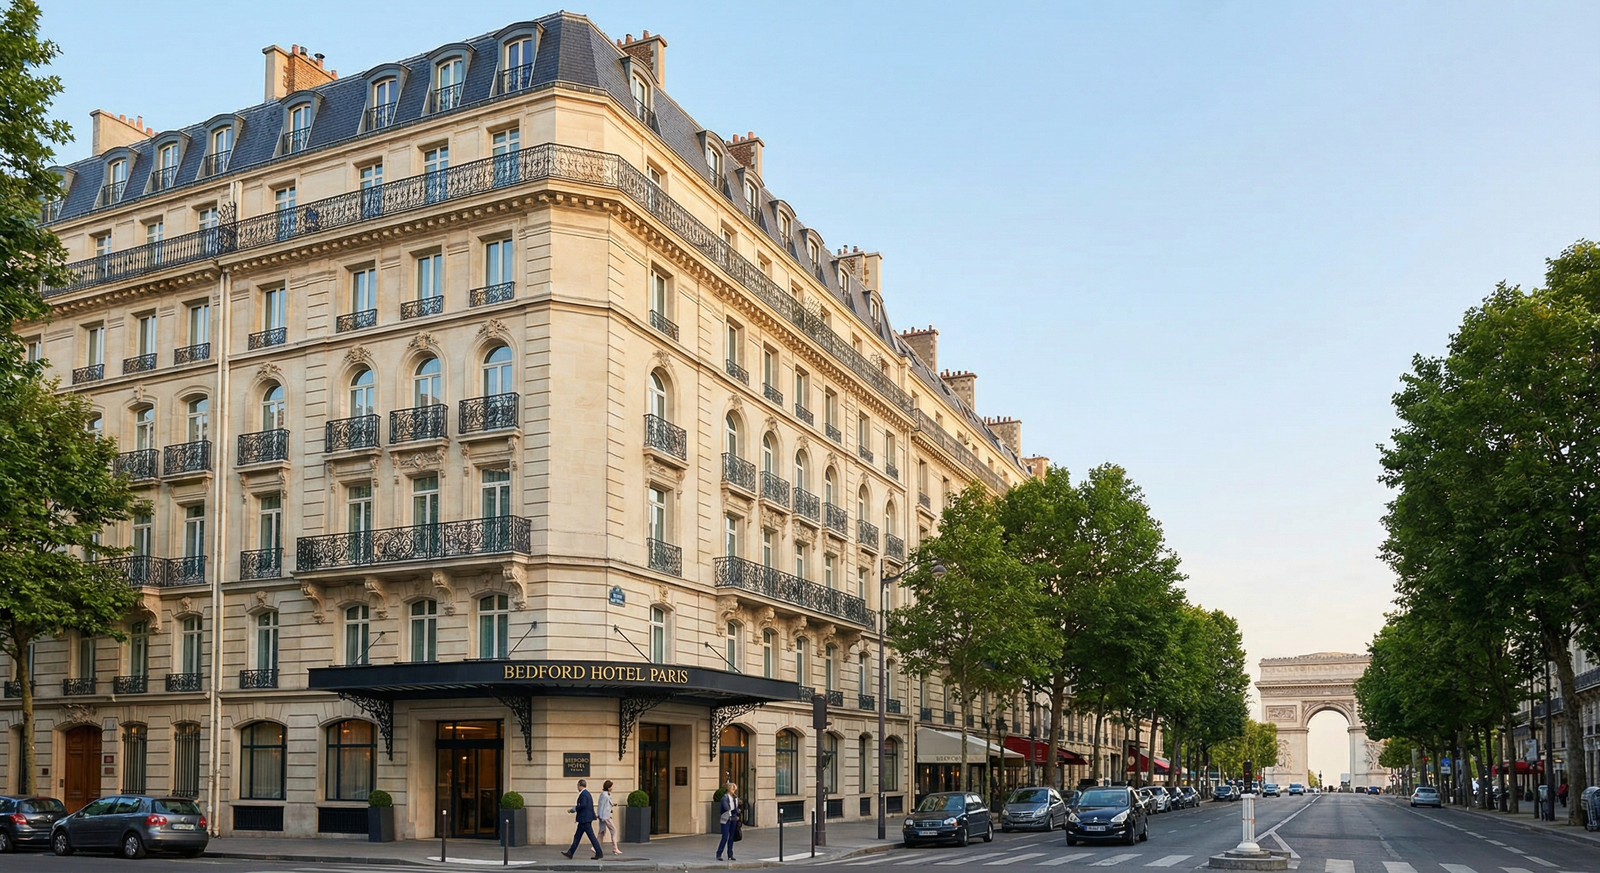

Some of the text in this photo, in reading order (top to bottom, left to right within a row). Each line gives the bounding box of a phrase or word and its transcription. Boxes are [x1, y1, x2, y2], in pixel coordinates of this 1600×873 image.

[503, 665, 688, 684] BEDFORD HOTEL PARIS
